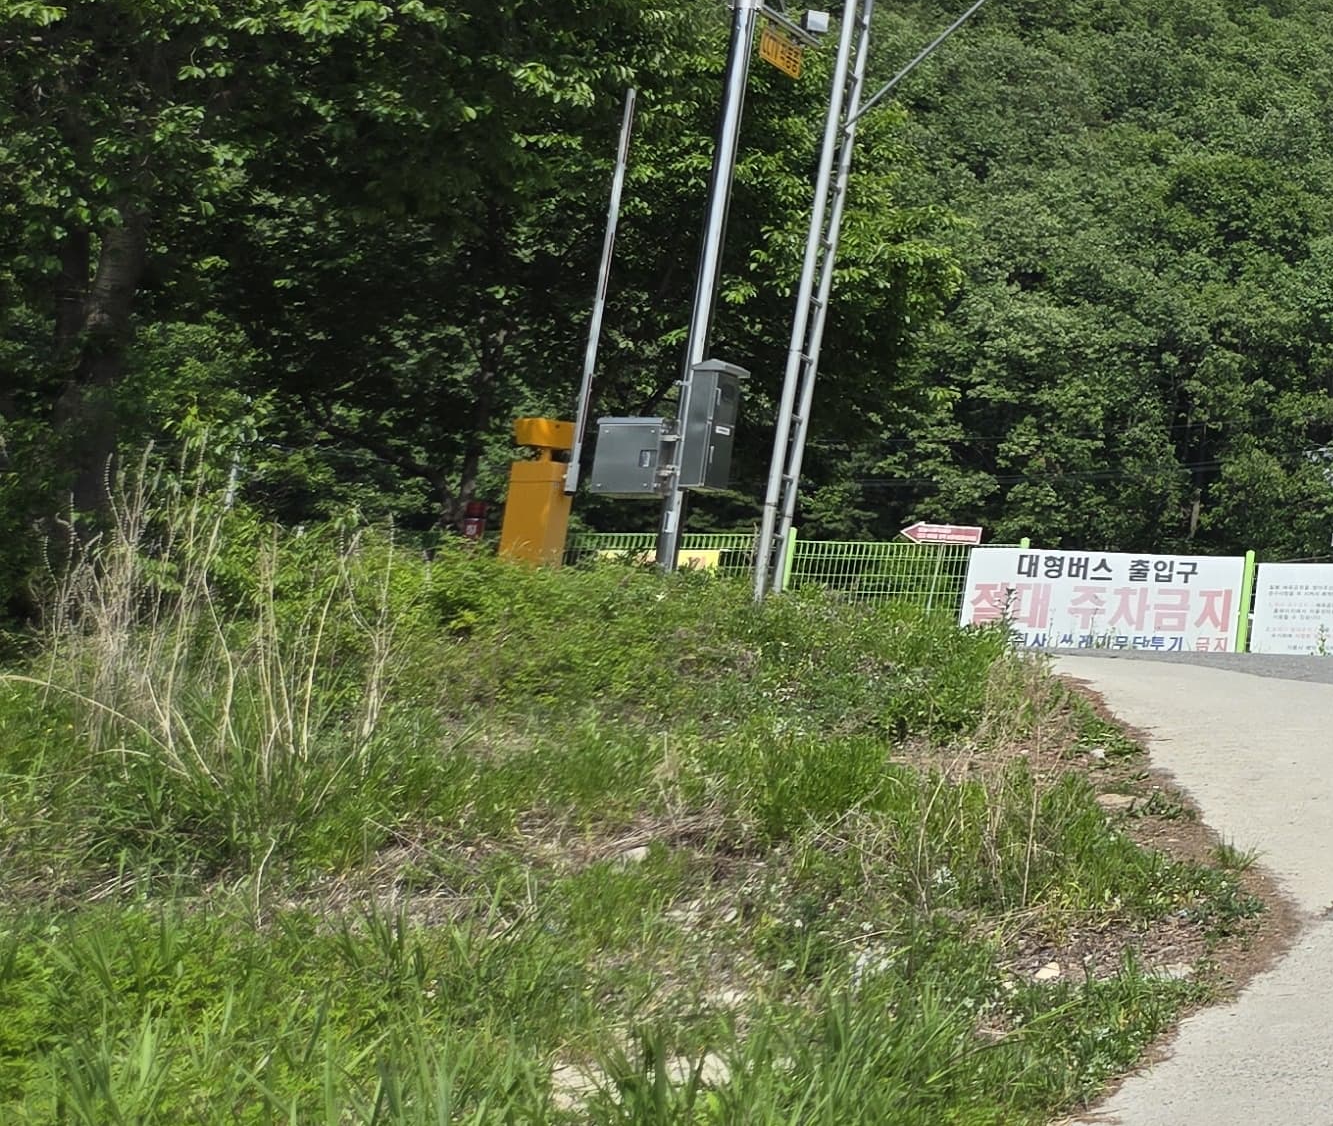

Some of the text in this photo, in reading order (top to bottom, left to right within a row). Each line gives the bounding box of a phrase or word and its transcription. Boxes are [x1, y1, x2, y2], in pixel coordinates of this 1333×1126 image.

[1016, 553, 1199, 584] 대형버스 출입구
[970, 582, 1233, 634] 절대 주차금지
[1196, 636, 1228, 653] 금지
